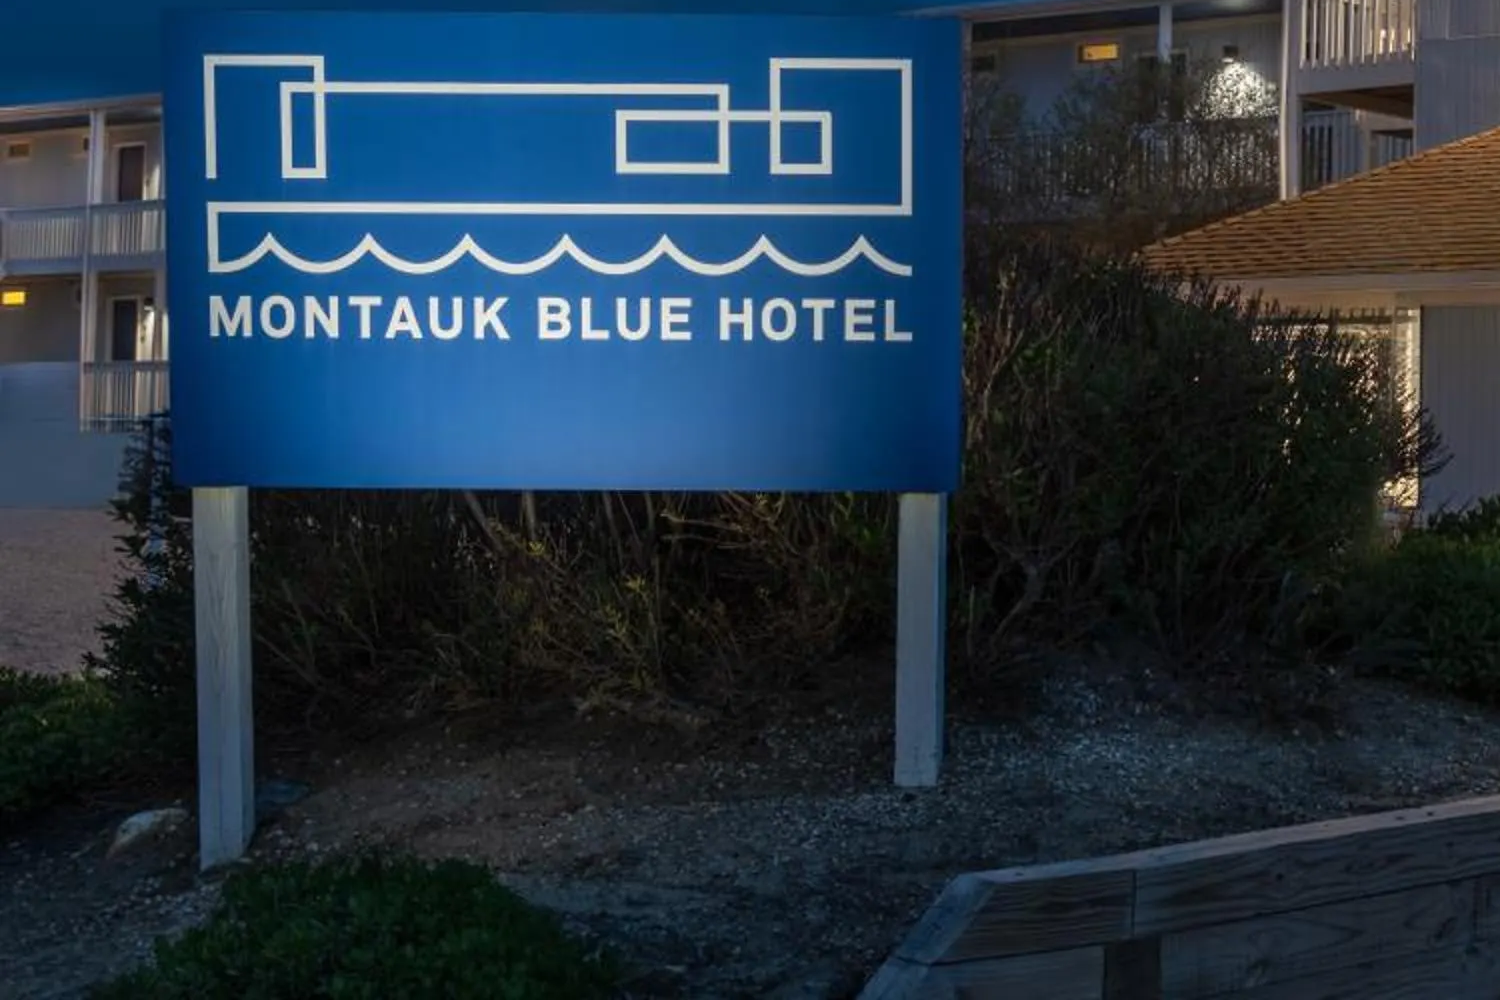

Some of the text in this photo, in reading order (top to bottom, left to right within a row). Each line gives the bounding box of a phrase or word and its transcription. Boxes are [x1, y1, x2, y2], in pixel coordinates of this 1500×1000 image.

[209, 295, 913, 342] MONTAUK BLUE HOTEL
